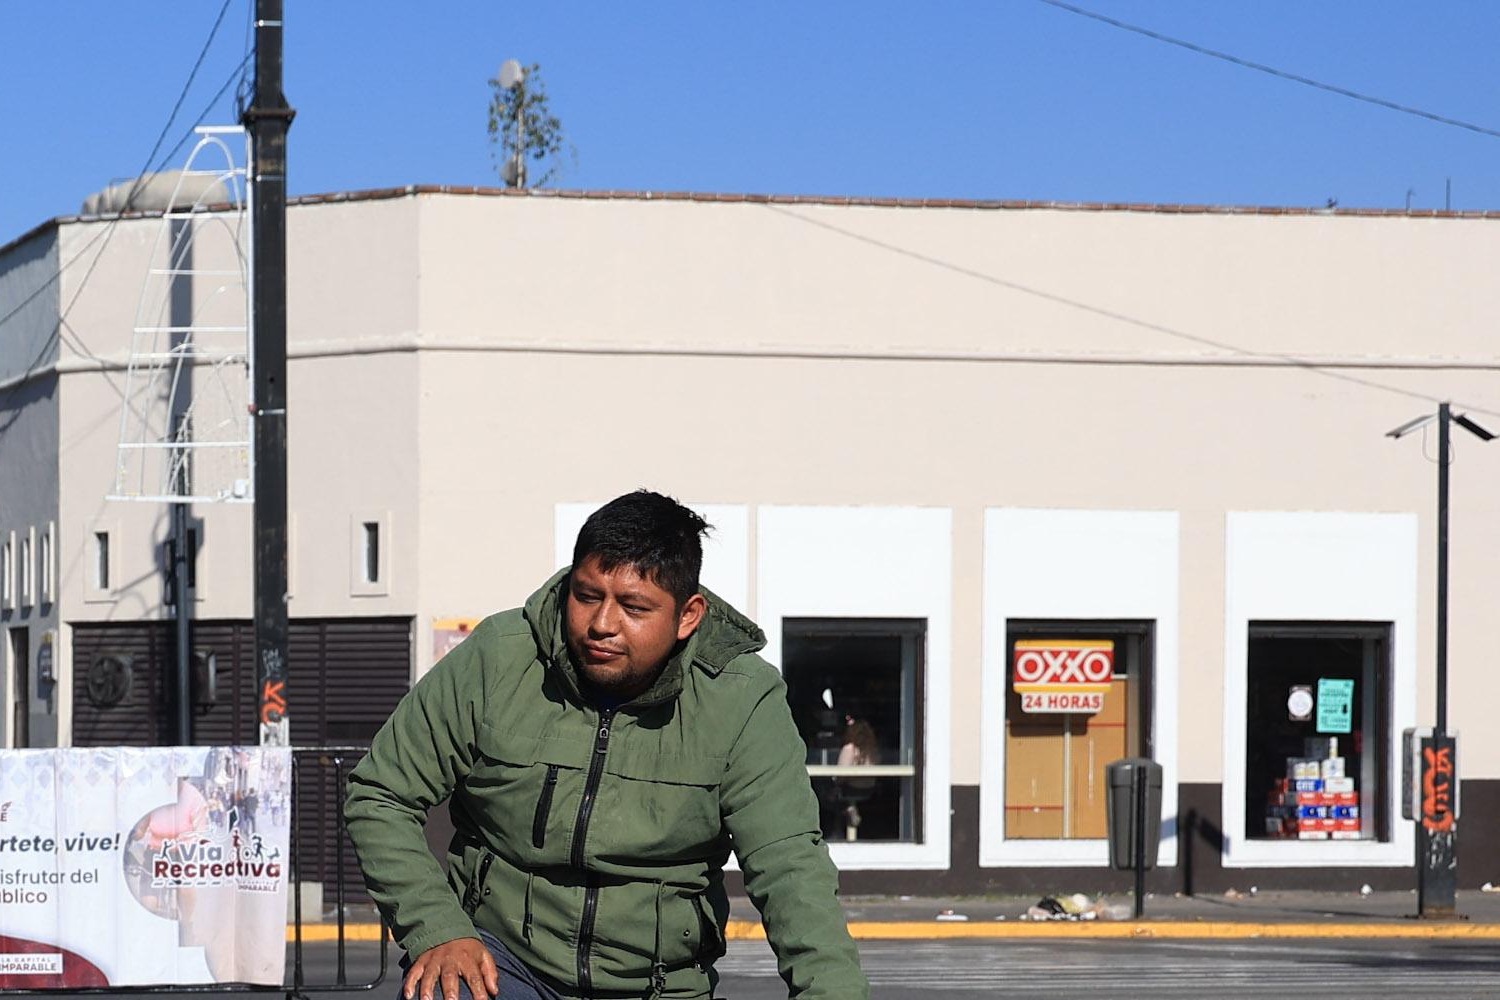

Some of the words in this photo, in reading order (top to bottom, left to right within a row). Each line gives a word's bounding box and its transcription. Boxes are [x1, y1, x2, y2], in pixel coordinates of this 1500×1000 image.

[1017, 648, 1111, 684] OXXO
[1025, 696, 1043, 709] 24
[1048, 696, 1100, 709] HORAS
[65, 832, 120, 851] vive!
[70, 868, 99, 884] del
[155, 861, 280, 878] Recreativa
